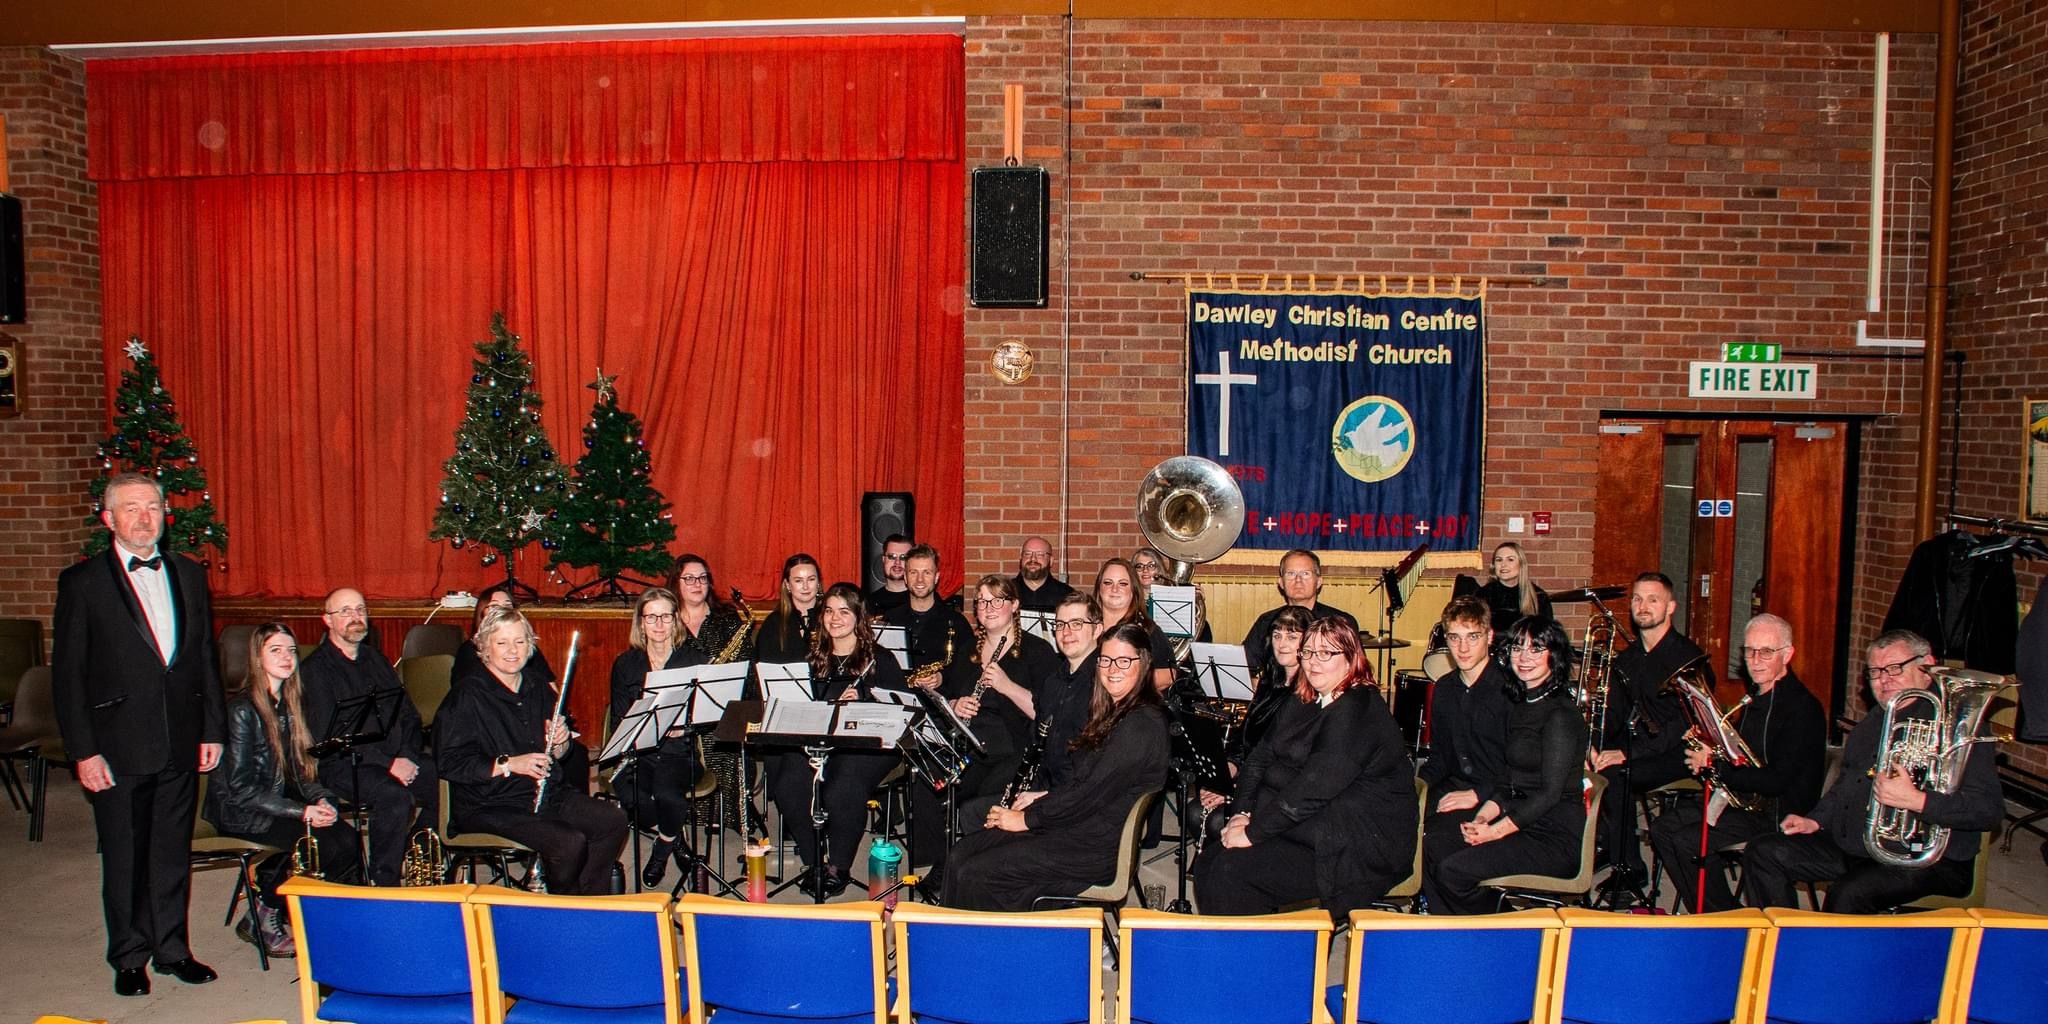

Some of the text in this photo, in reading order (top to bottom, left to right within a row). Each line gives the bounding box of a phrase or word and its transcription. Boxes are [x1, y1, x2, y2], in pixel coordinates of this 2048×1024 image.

[1194, 302, 1477, 331] Dawley Christian Centre
[1240, 337, 1452, 364] Methodist Church
[1700, 367, 1810, 392] FIRE EXIT
[1279, 511, 1331, 536] HOPE
[1348, 512, 1415, 538] PEACE
[1431, 514, 1469, 538] JOY
